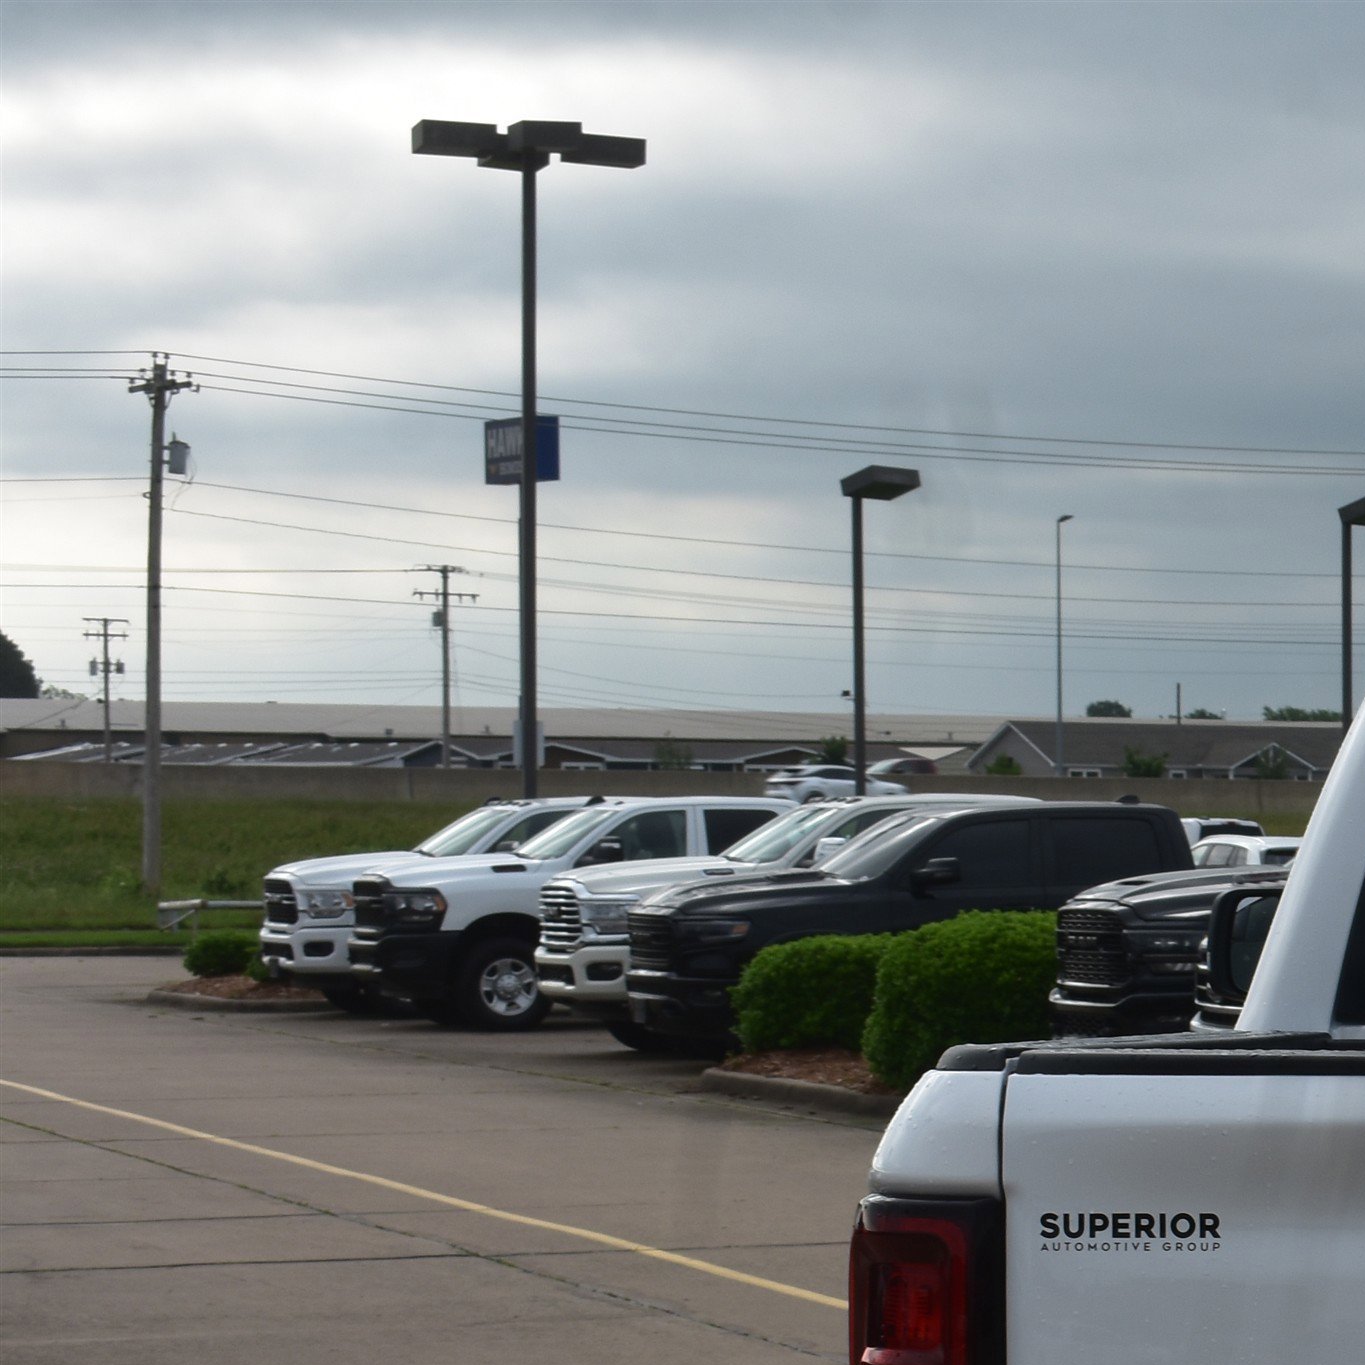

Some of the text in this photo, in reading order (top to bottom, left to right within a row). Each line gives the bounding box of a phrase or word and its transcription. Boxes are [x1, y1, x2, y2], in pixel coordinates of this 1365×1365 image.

[1040, 1213, 1221, 1239] SUPERIOR
[1041, 1242, 1221, 1252] AUTOMOTIVE GROUP
